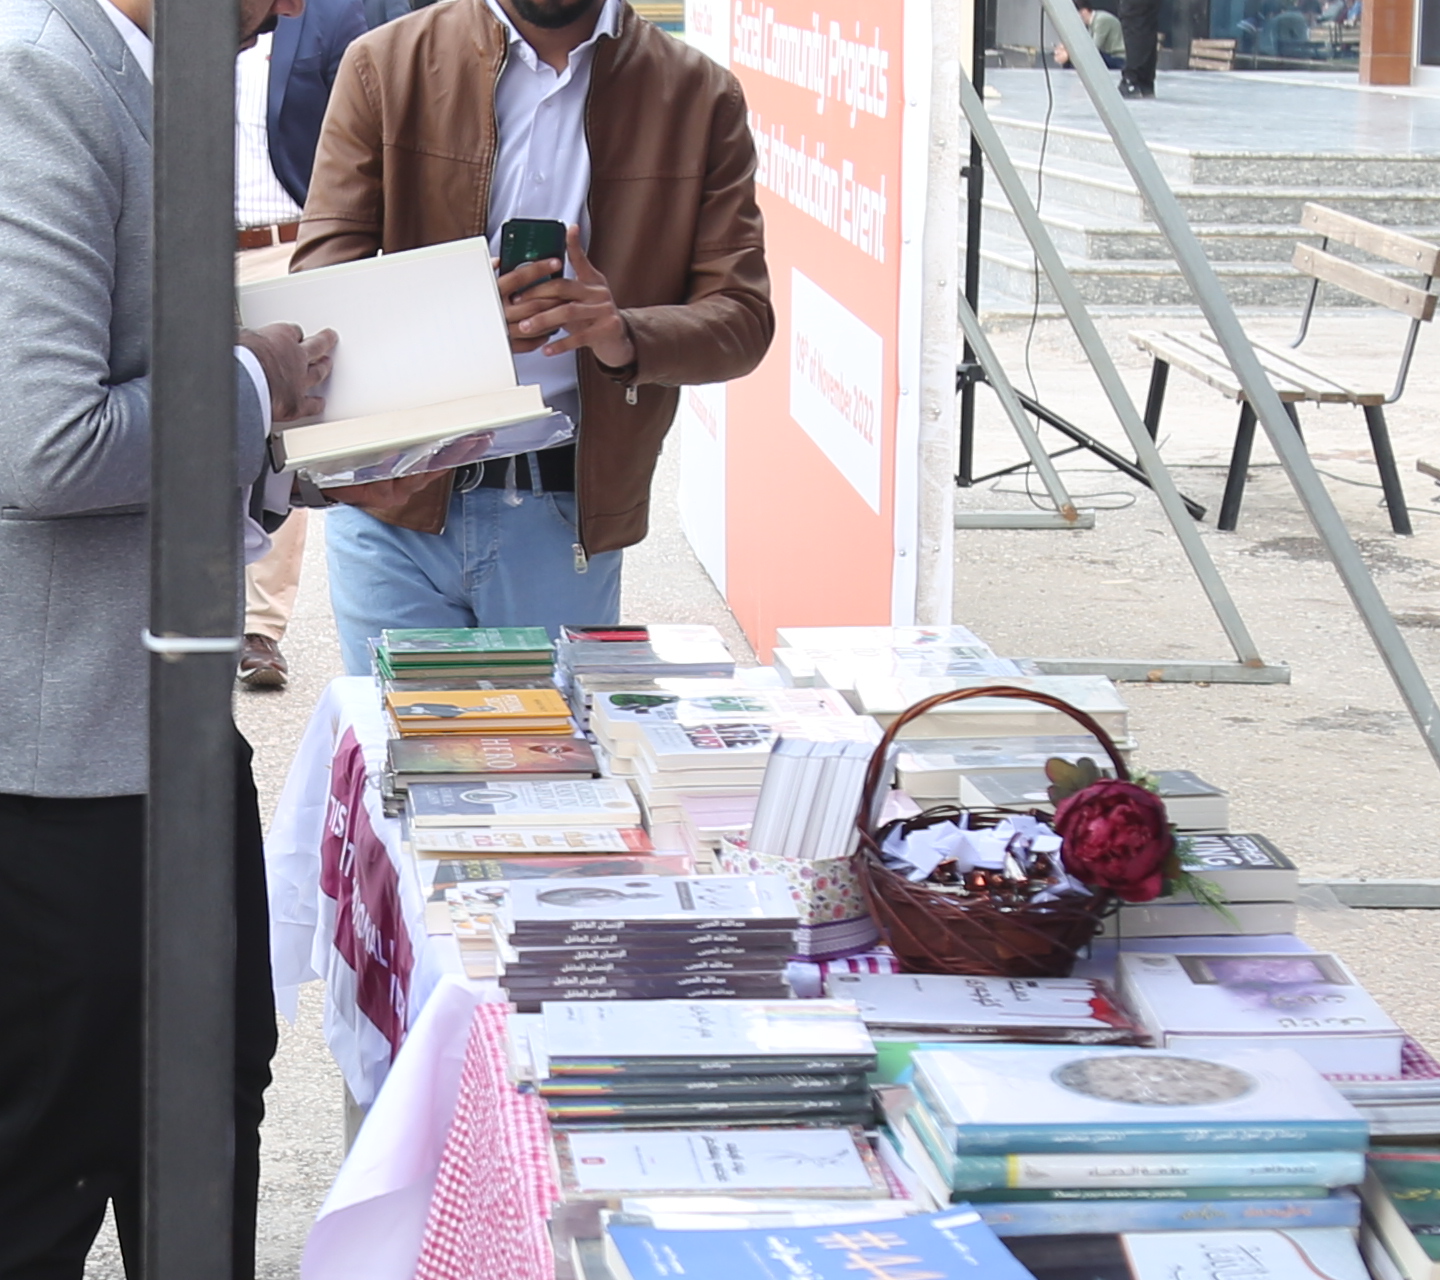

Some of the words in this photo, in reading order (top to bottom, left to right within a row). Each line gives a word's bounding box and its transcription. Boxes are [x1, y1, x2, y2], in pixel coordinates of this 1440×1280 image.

[732, 0, 764, 74] Social
[764, 9, 830, 116] Community
[830, 20, 890, 130] Projects
[769, 122, 839, 233] Introduction
[840, 158, 887, 264] Event
[817, 350, 852, 423] November
[853, 384, 875, 447] 2022
[480, 738, 518, 770] HERO
[1187, 836, 1243, 866] KING
